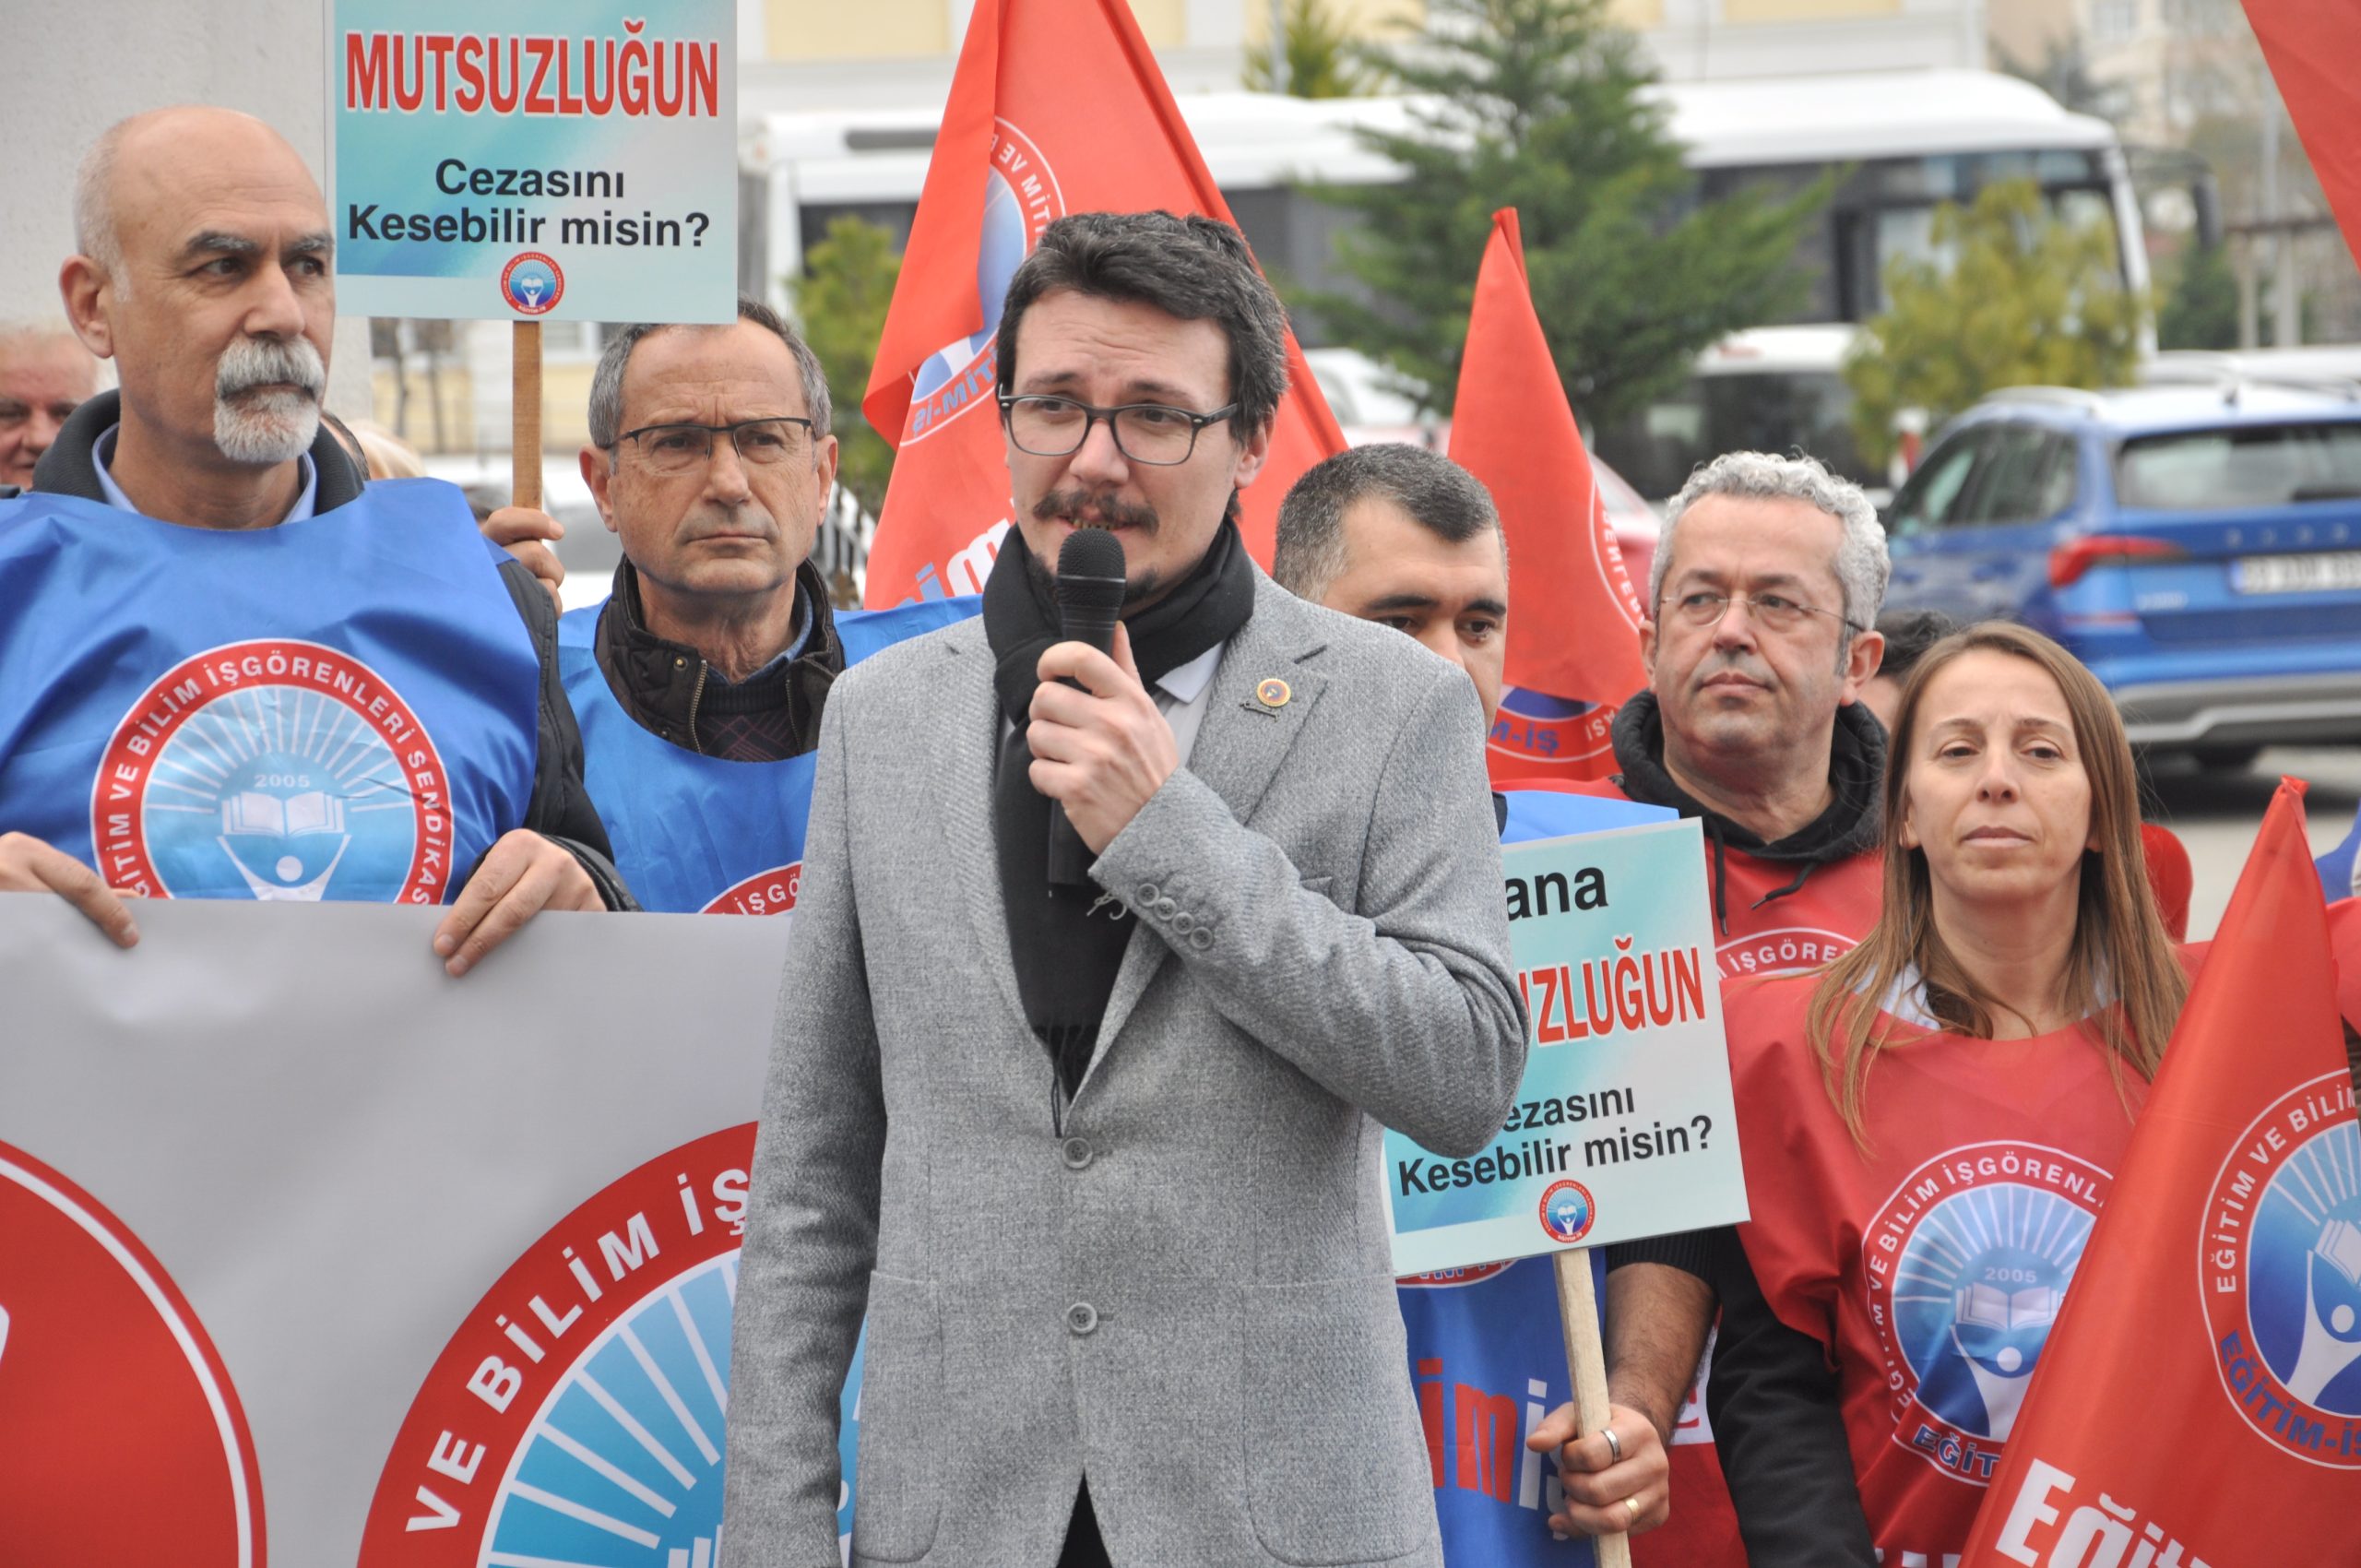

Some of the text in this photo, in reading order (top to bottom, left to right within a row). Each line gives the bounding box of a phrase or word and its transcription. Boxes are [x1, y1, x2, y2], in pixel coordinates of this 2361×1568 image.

[346, 20, 718, 117] MUTSUZLUĞUN
[435, 159, 624, 198] Cezasını
[349, 204, 710, 246] Kesebilir misin?
[106, 650, 445, 904] ĞİTİM VE BİLİM İŞGÖRENLERİ SENDİKAS
[254, 773, 311, 789] 2005
[734, 873, 799, 915] İŞGÖ
[1505, 866, 1608, 921] ana
[1727, 938, 1847, 972] İŞGÖRE
[1519, 936, 1705, 1043] ZLUĞUN
[1501, 1087, 1635, 1132] ezasını
[1399, 1115, 1713, 1196] Kesebilir misin?
[1869, 1254, 1888, 1289] VE
[1879, 1177, 1940, 1250] BİLİM
[1942, 1151, 2105, 1206] İŞGÖRENL
[2210, 1170, 2256, 1293] EĞİTİM
[2248, 1126, 2287, 1165] VE
[1984, 1267, 2037, 1284] 2005
[406, 1168, 751, 1533] VE BİLİM İŞ
[1914, 1424, 2000, 1478] EĞİT
